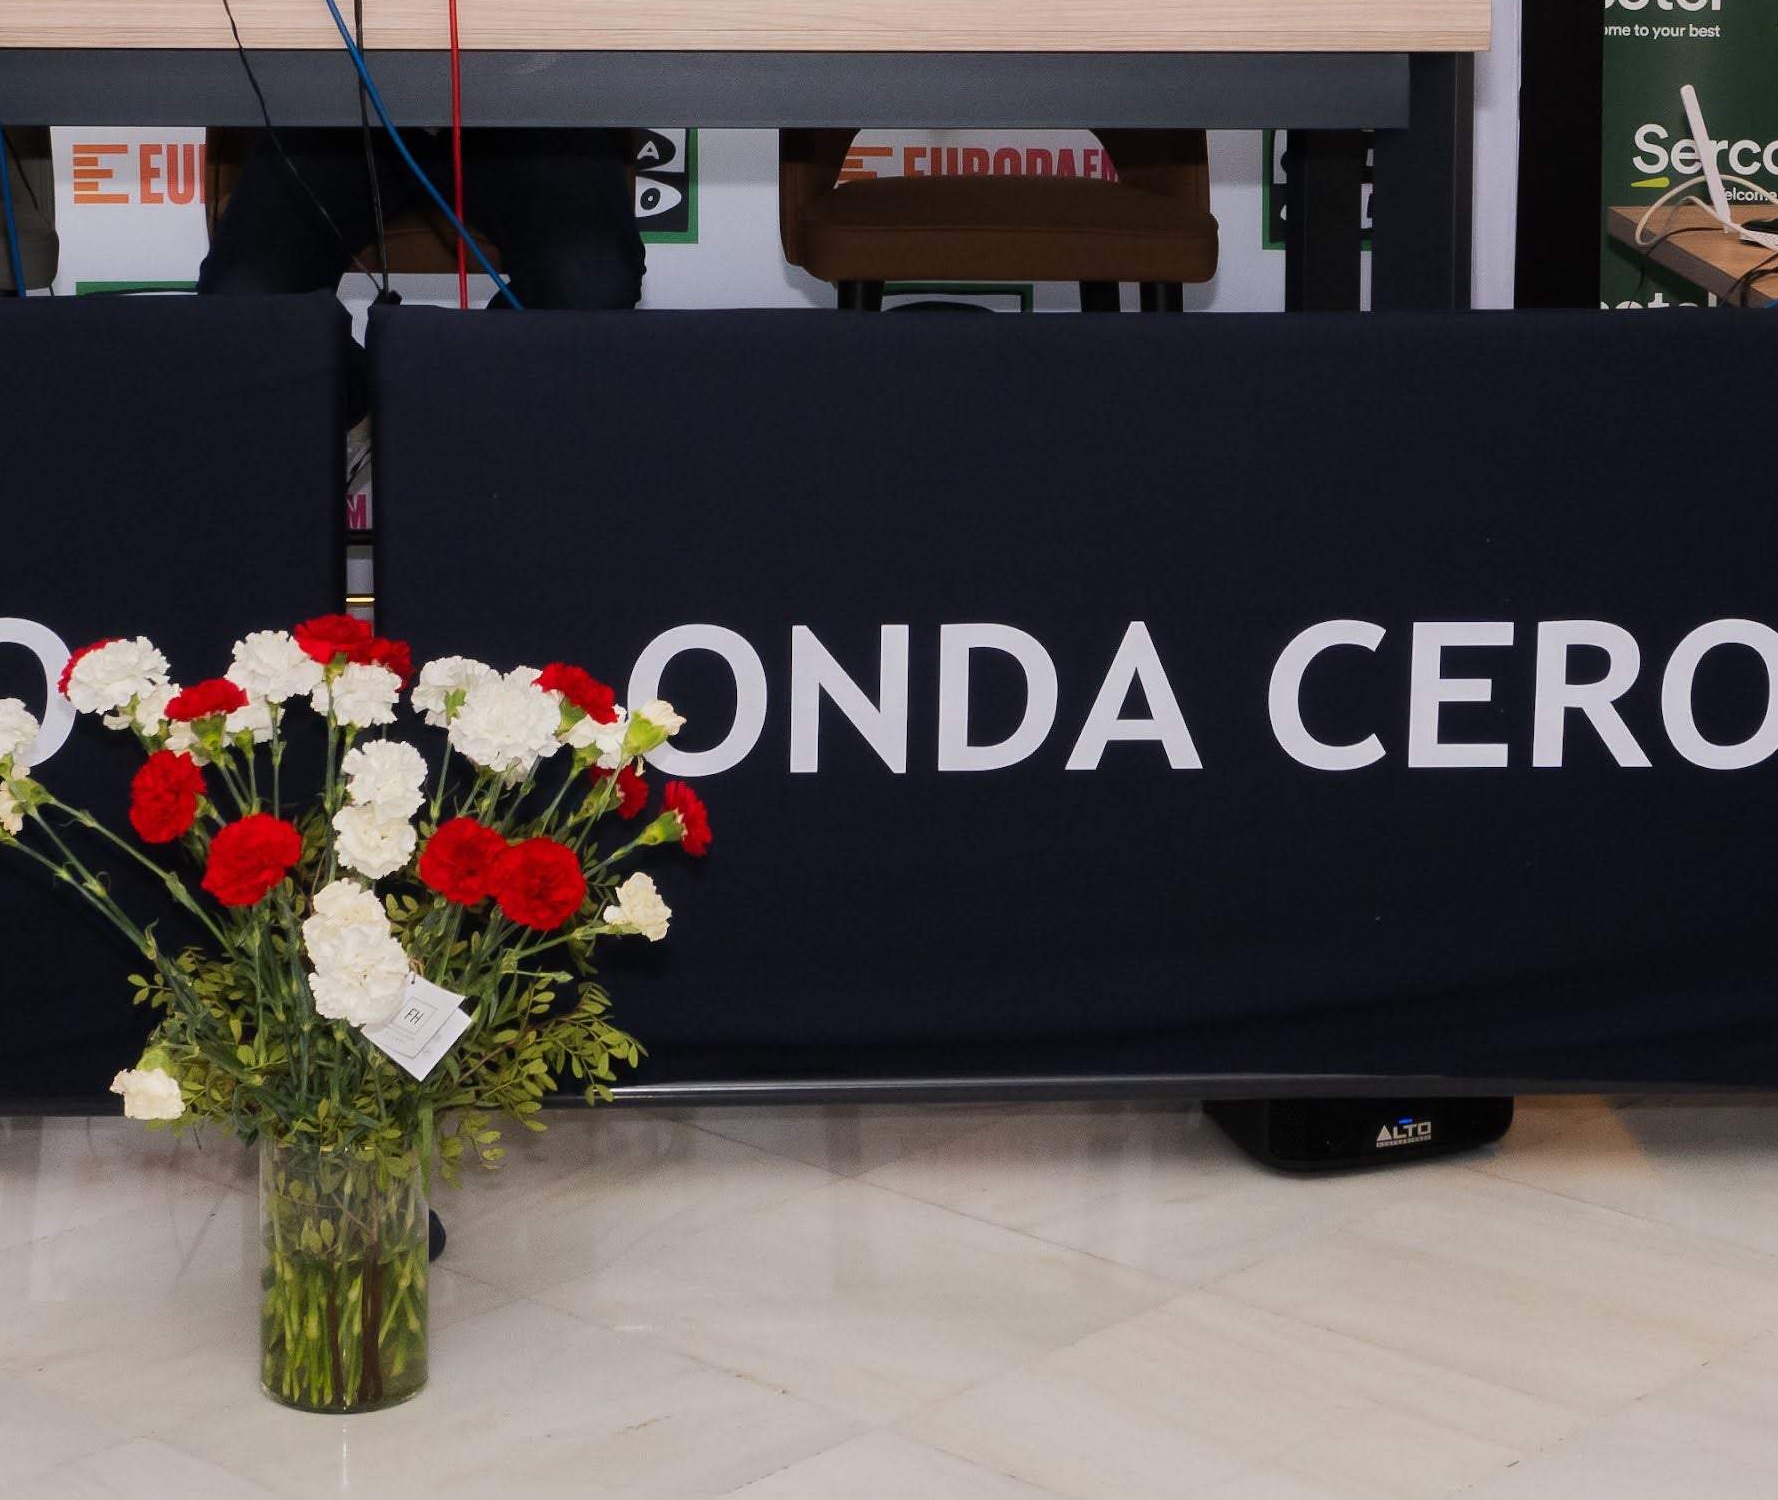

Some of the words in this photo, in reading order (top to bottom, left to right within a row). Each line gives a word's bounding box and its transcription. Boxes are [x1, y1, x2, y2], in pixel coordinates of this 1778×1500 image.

[1634, 25, 1649, 36] to
[1652, 27, 1686, 39] your
[1689, 24, 1720, 37] best
[627, 622, 1204, 778] ONDA
[1376, 1122, 1432, 1141] ALTO
